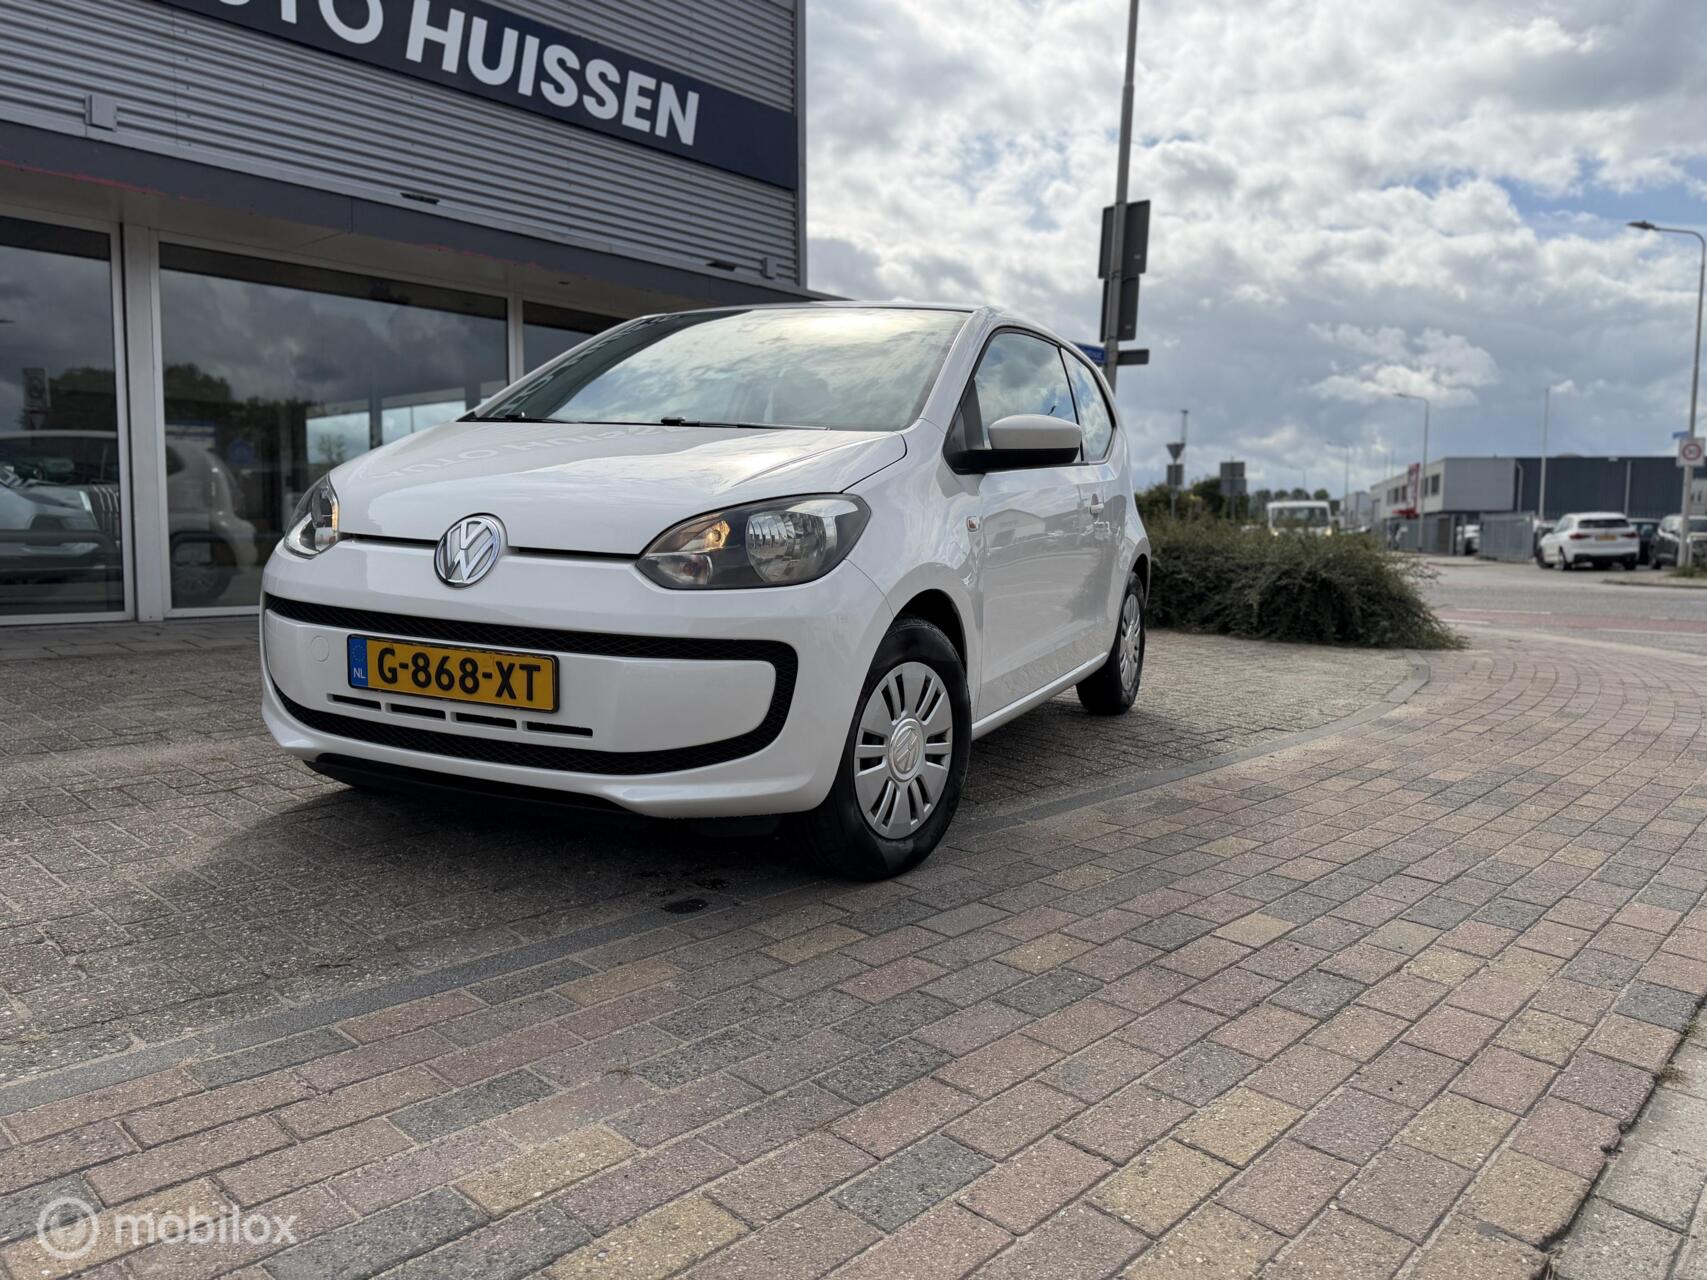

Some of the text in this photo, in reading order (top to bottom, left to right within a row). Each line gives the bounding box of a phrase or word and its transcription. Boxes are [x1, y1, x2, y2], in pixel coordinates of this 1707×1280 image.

[405, 0, 700, 146] HUISSEN
[353, 668, 366, 679] NL
[377, 647, 541, 701] G-868-XT
